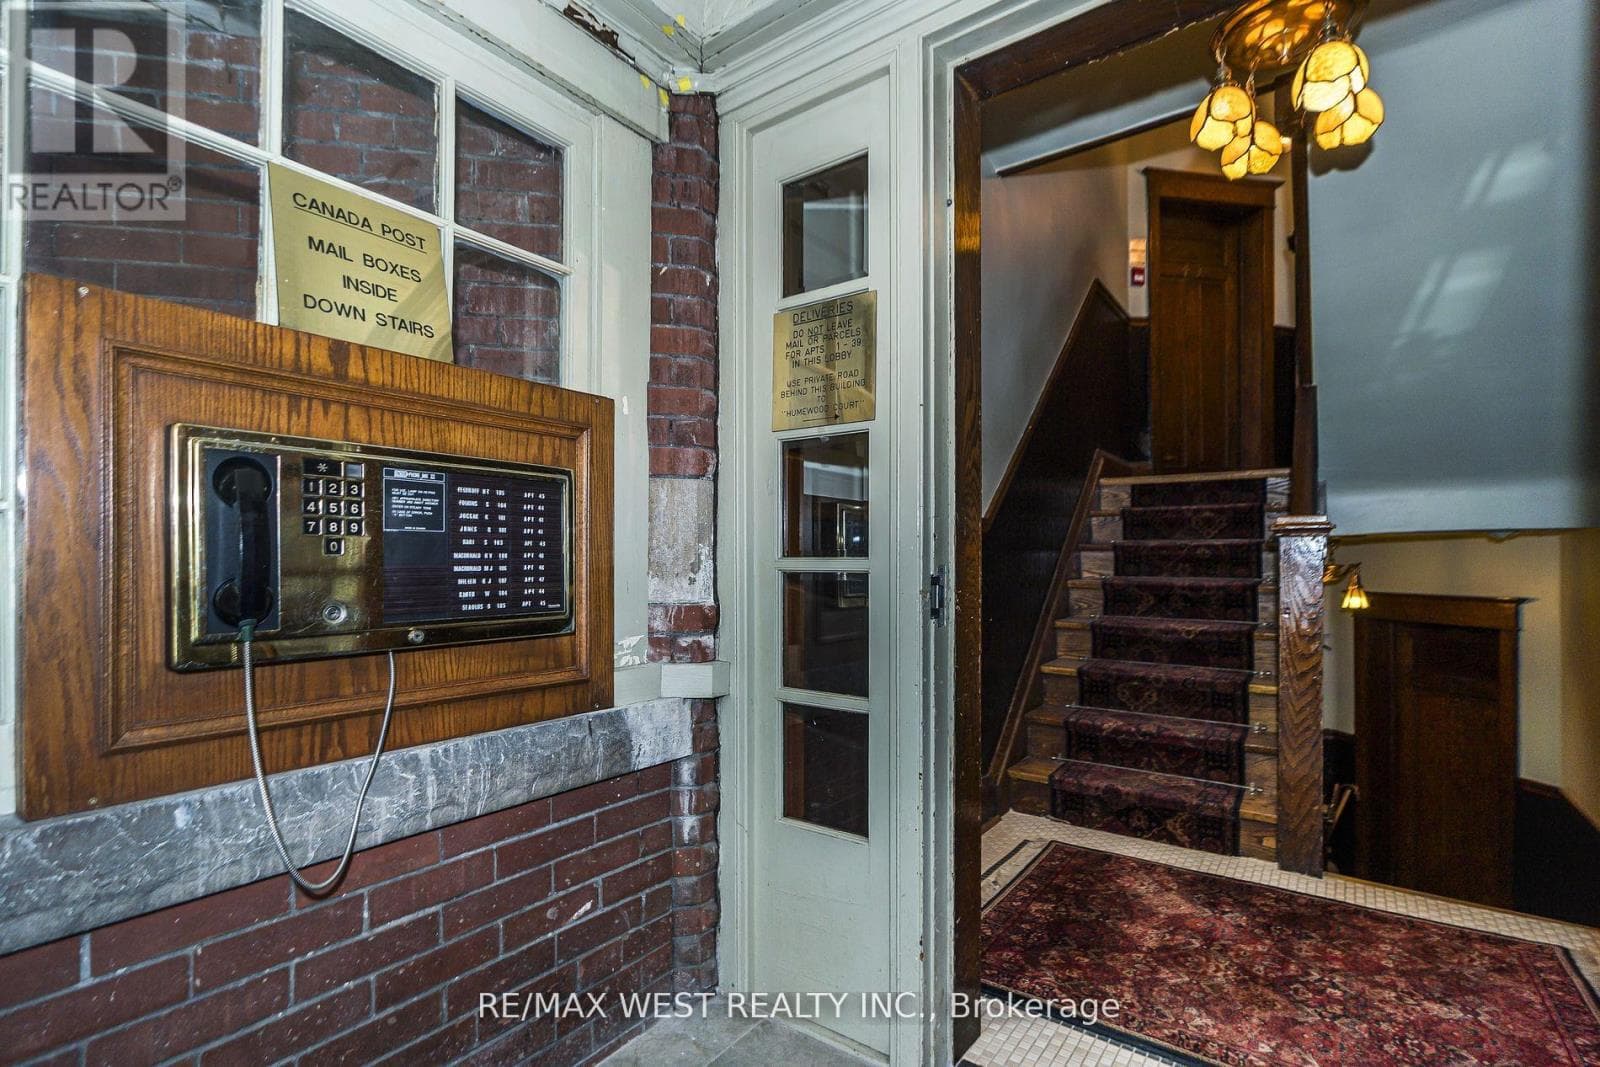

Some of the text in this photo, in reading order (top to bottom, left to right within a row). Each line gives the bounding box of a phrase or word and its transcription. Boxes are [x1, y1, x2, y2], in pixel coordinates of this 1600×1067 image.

[292, 192, 426, 250] CANADA POST
[307, 236, 422, 283] MAIL BOXES
[343, 275, 398, 302] INSIDE
[303, 293, 434, 339] DOWN STAIRS
[793, 301, 854, 324] DELIVERIES
[793, 319, 853, 339] DO NOT LEAVE
[785, 327, 861, 351] MAIL OR PARCELS
[785, 350, 801, 360] FOR
[805, 345, 825, 357] APTS
[792, 352, 852, 369] IN THIS LOBBY
[786, 369, 859, 388] USE PRIVATE ROAD
[780, 379, 866, 399] BEHIND THIS BUILDING
[817, 395, 826, 403] TO
[309, 481, 359, 495] 1 2 3
[306, 501, 359, 514] 4 5 6
[307, 521, 359, 533] 7 8 9
[330, 541, 338, 552] 0
